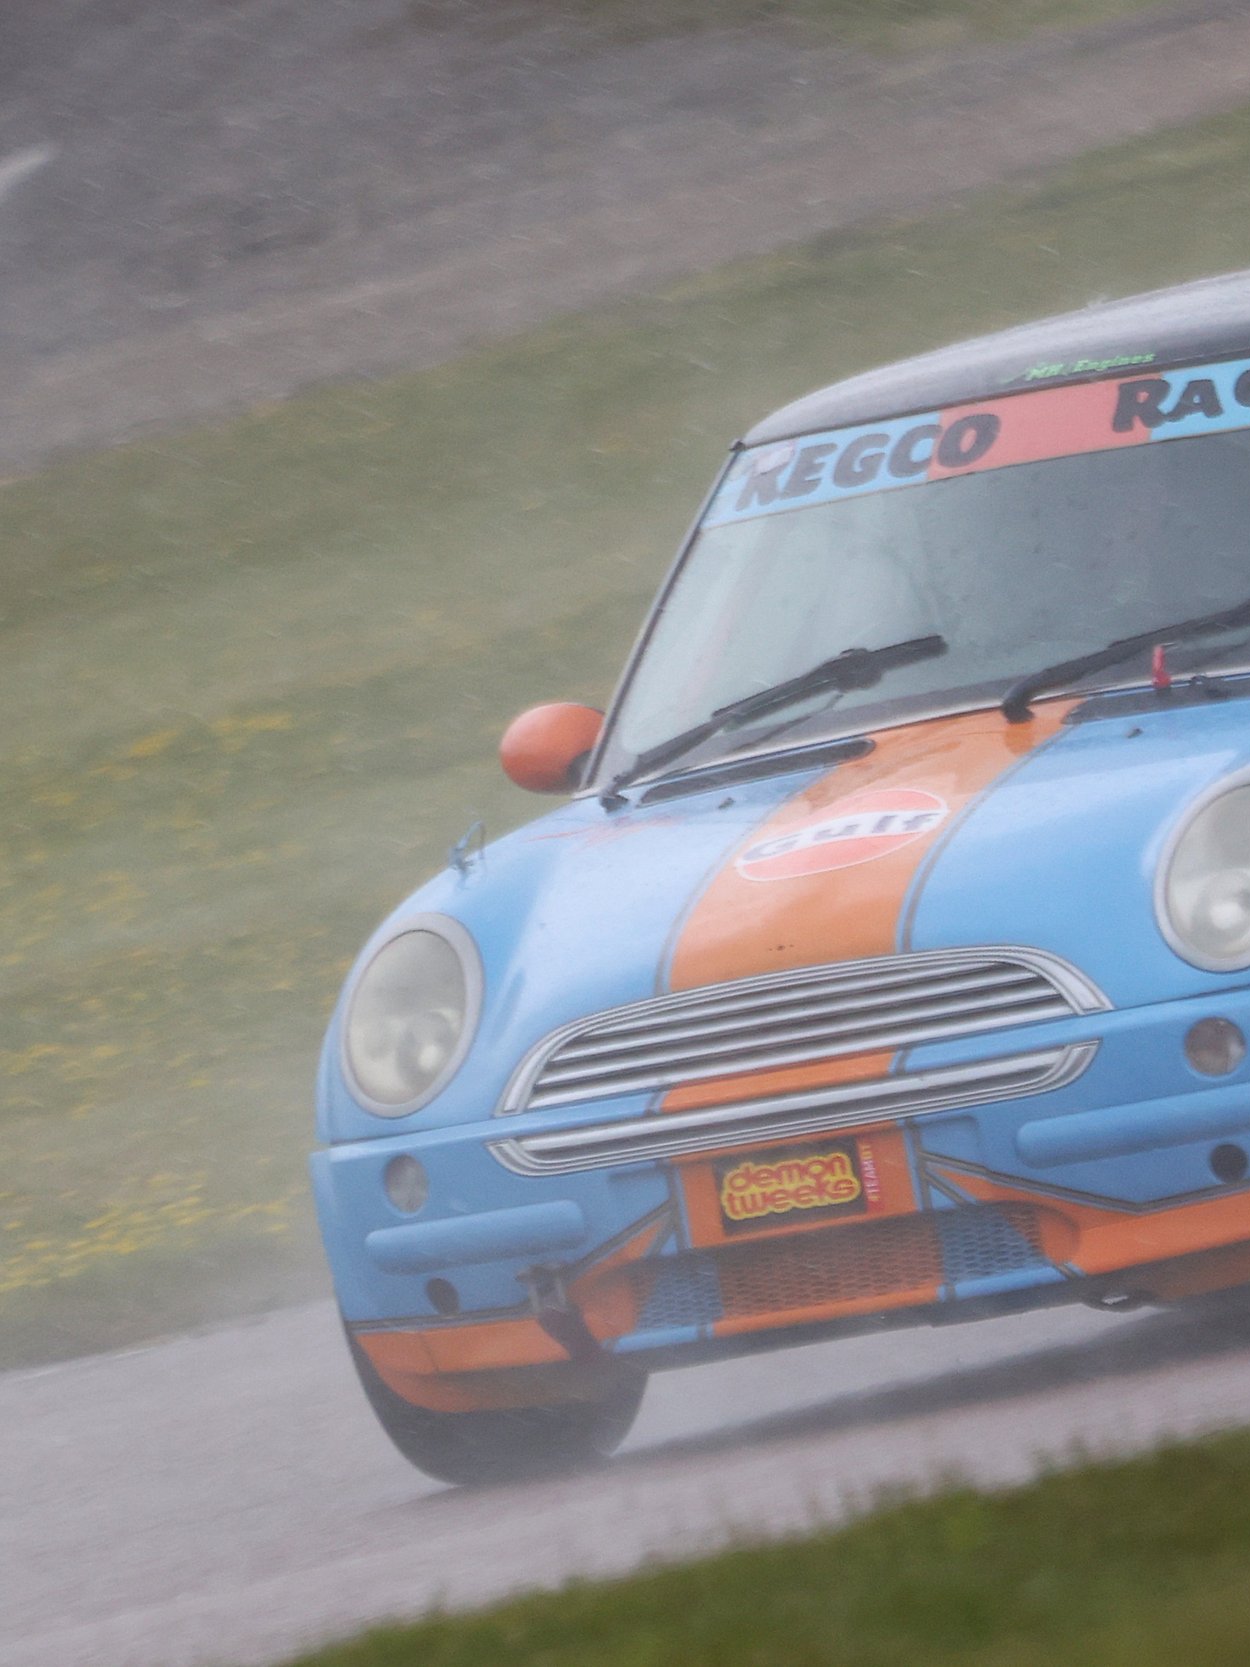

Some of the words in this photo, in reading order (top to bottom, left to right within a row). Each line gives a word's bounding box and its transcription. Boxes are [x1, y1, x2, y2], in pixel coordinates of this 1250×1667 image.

[741, 813, 940, 862] Gulf
[729, 1155, 849, 1192] demon
[727, 1177, 858, 1218] tweeks
